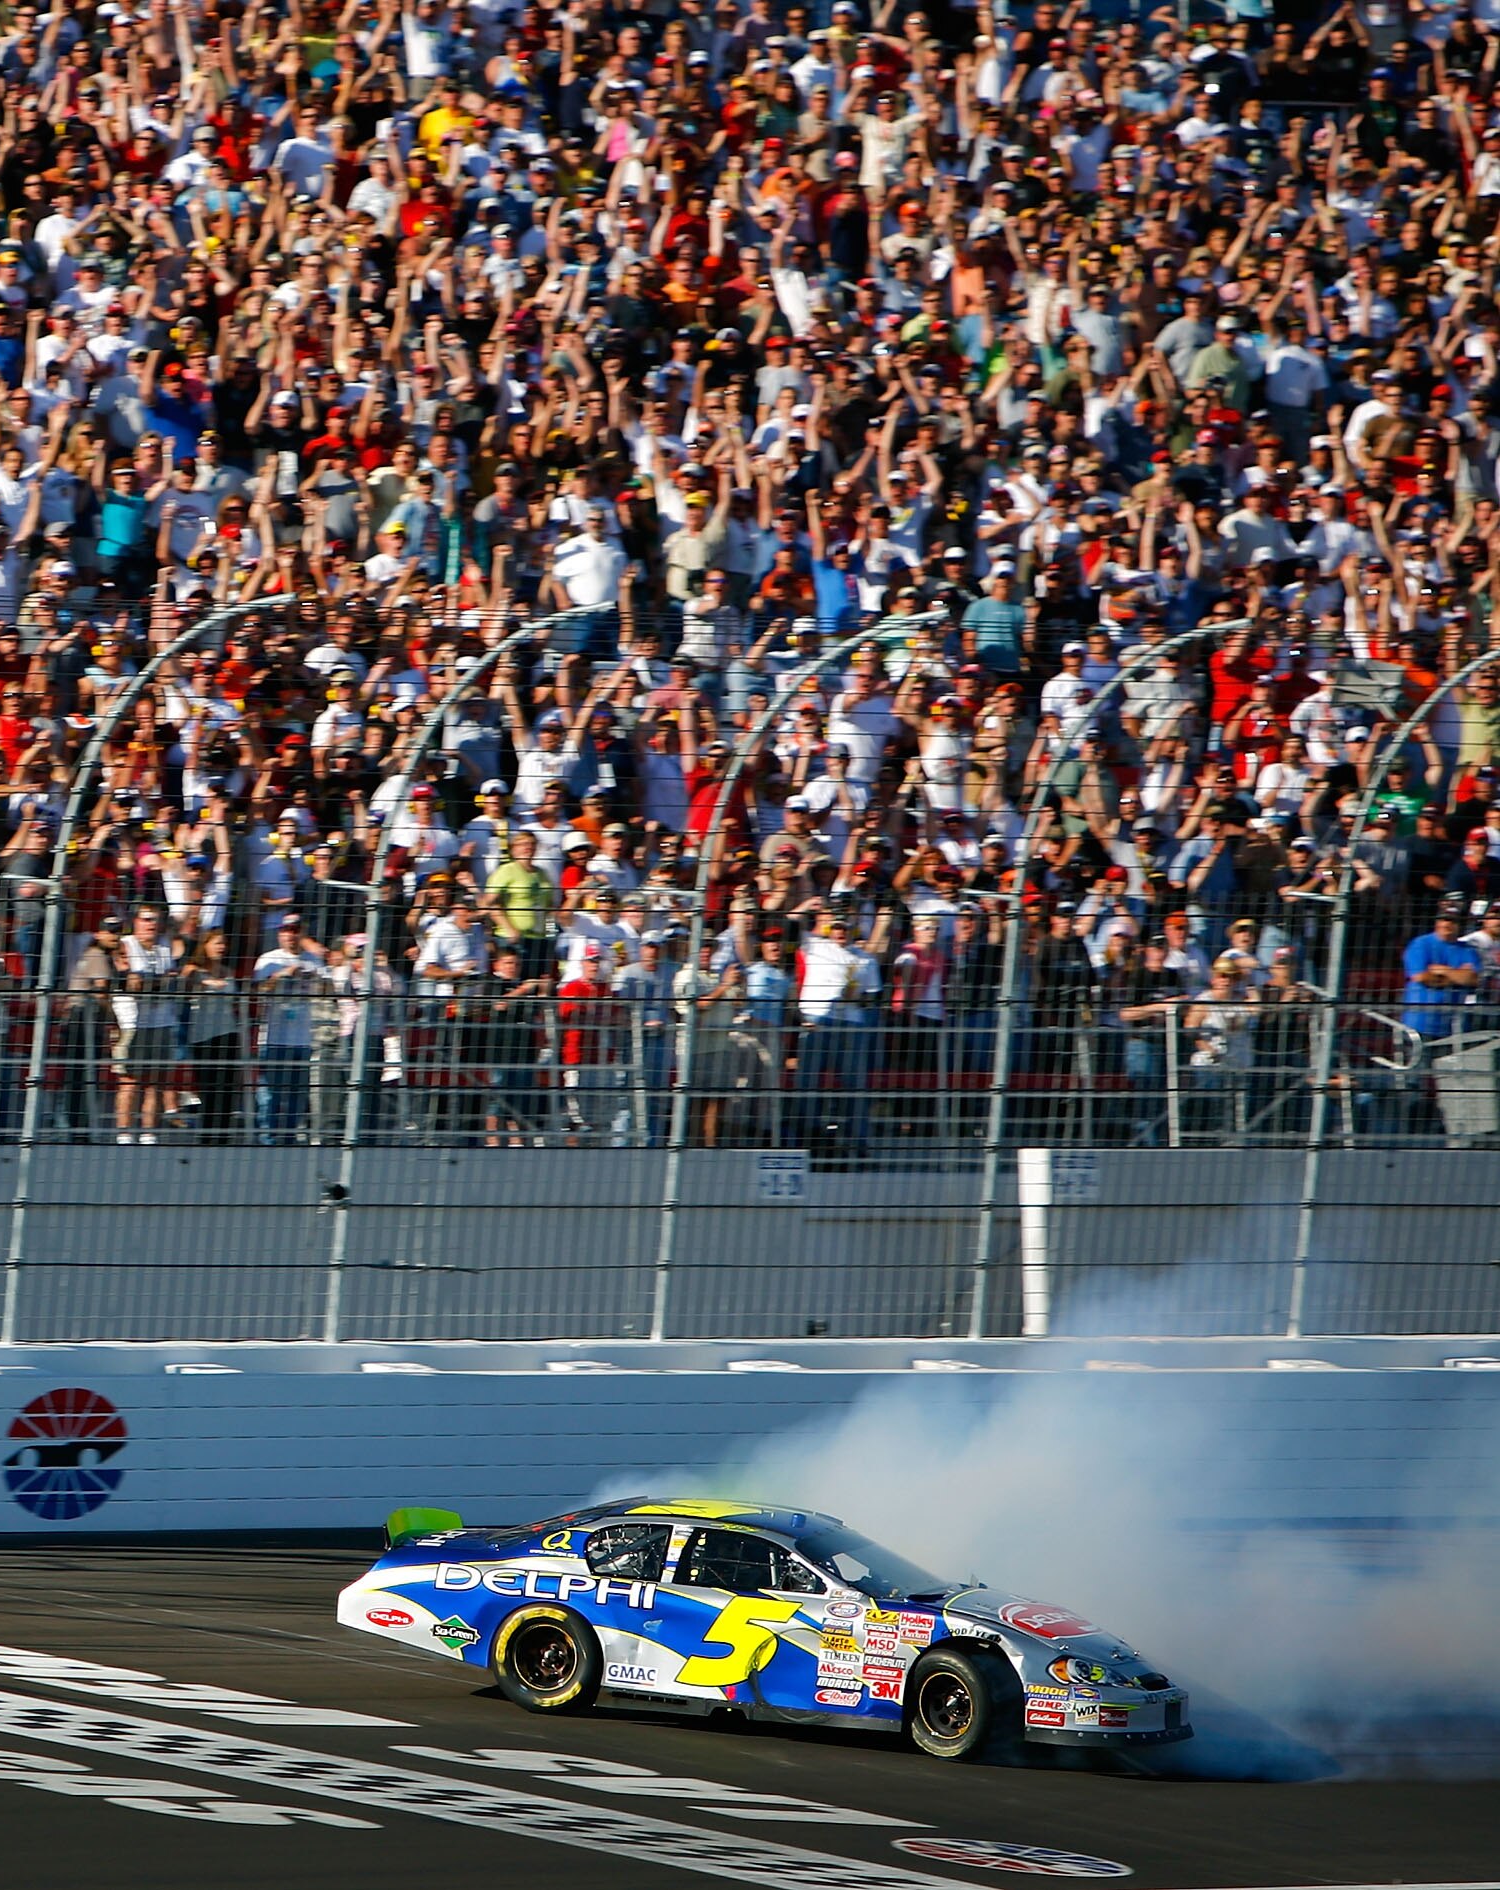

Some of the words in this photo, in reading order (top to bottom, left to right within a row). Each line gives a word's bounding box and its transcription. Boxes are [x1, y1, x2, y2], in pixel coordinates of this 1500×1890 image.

[542, 1531, 572, 1549] Q
[436, 1562, 657, 1609] DELPHI
[370, 1613, 409, 1624] DELPHI
[901, 1612, 933, 1629] Holley
[434, 1625, 474, 1641] Sta-Green
[675, 1595, 803, 1687] 5
[866, 1638, 896, 1651] MSD
[823, 1650, 860, 1662] TIMKEN
[608, 1665, 656, 1682] GMAC
[1090, 1666, 1103, 1680] 5
[871, 1682, 900, 1699] 3M
[1027, 1685, 1069, 1696] MOOG
[1029, 1700, 1062, 1709] COMP
[1077, 1705, 1098, 1717] WIX
